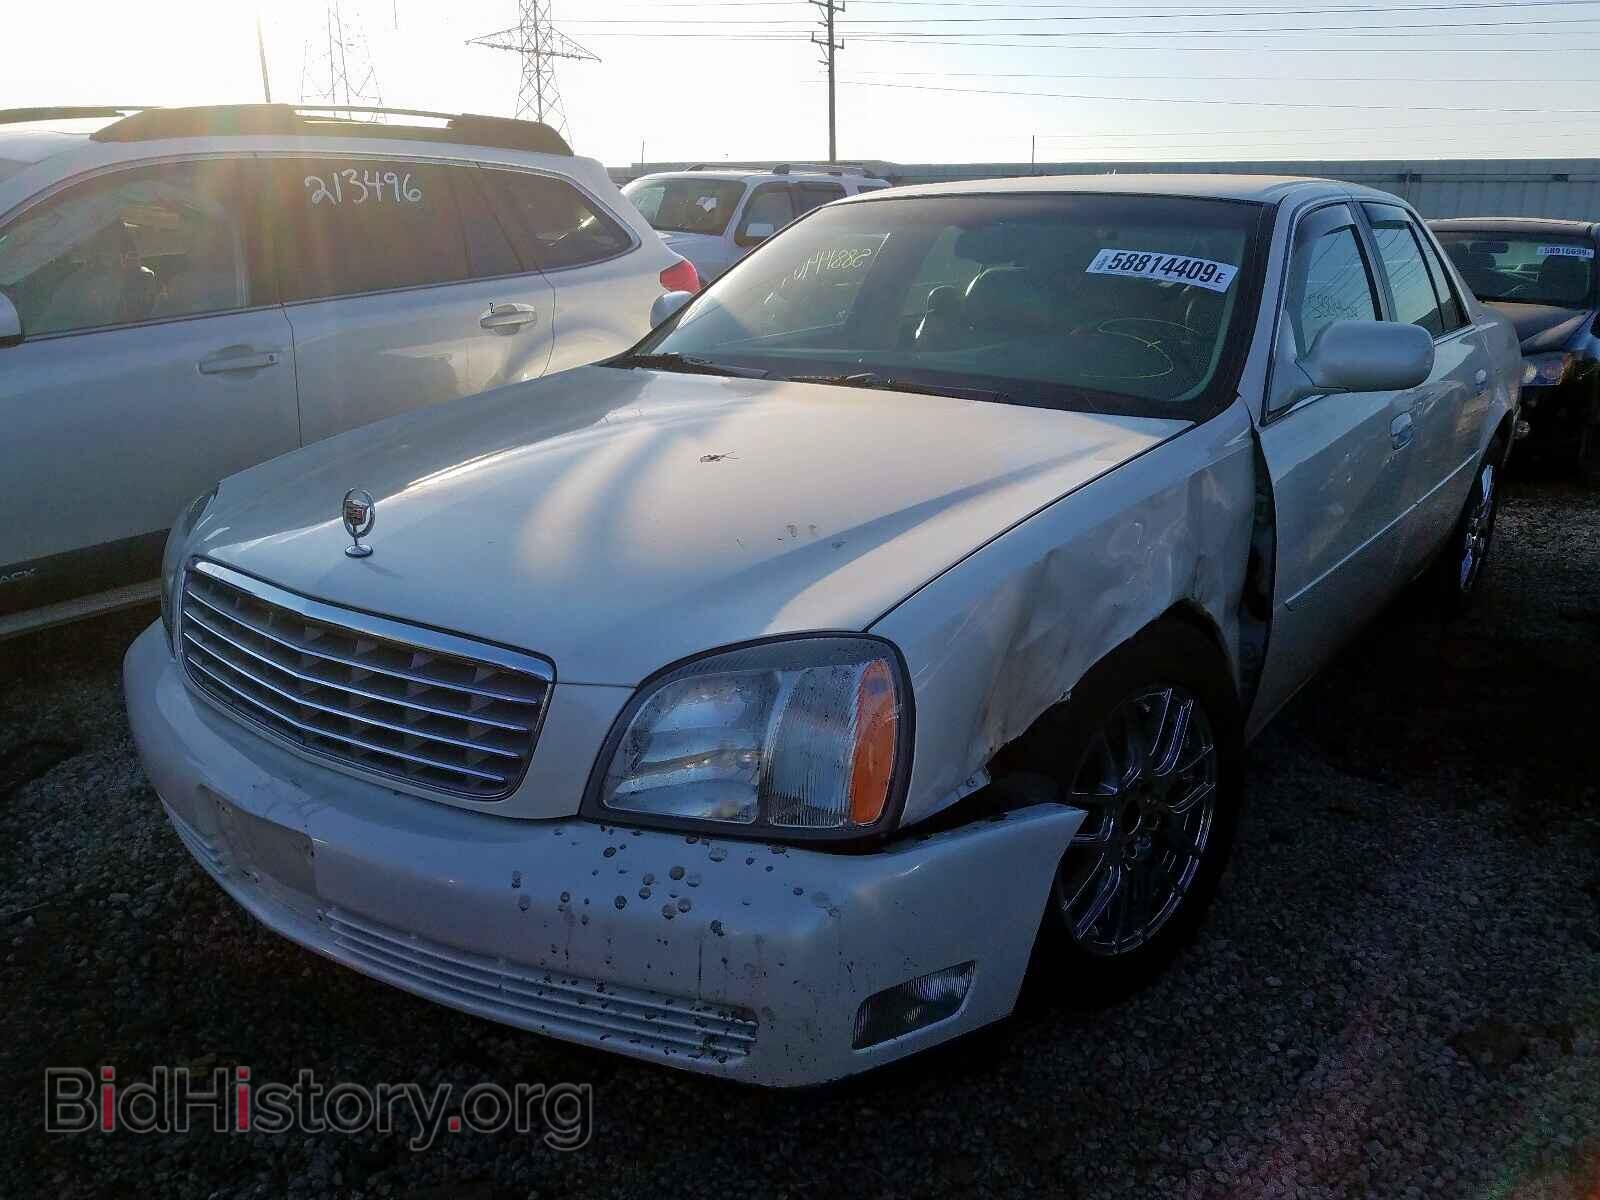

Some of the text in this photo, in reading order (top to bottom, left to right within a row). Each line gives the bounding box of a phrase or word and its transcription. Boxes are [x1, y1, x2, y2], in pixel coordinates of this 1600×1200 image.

[304, 169, 422, 204] 213496
[1108, 252, 1218, 283] 58814409
[1214, 272, 1226, 284] E
